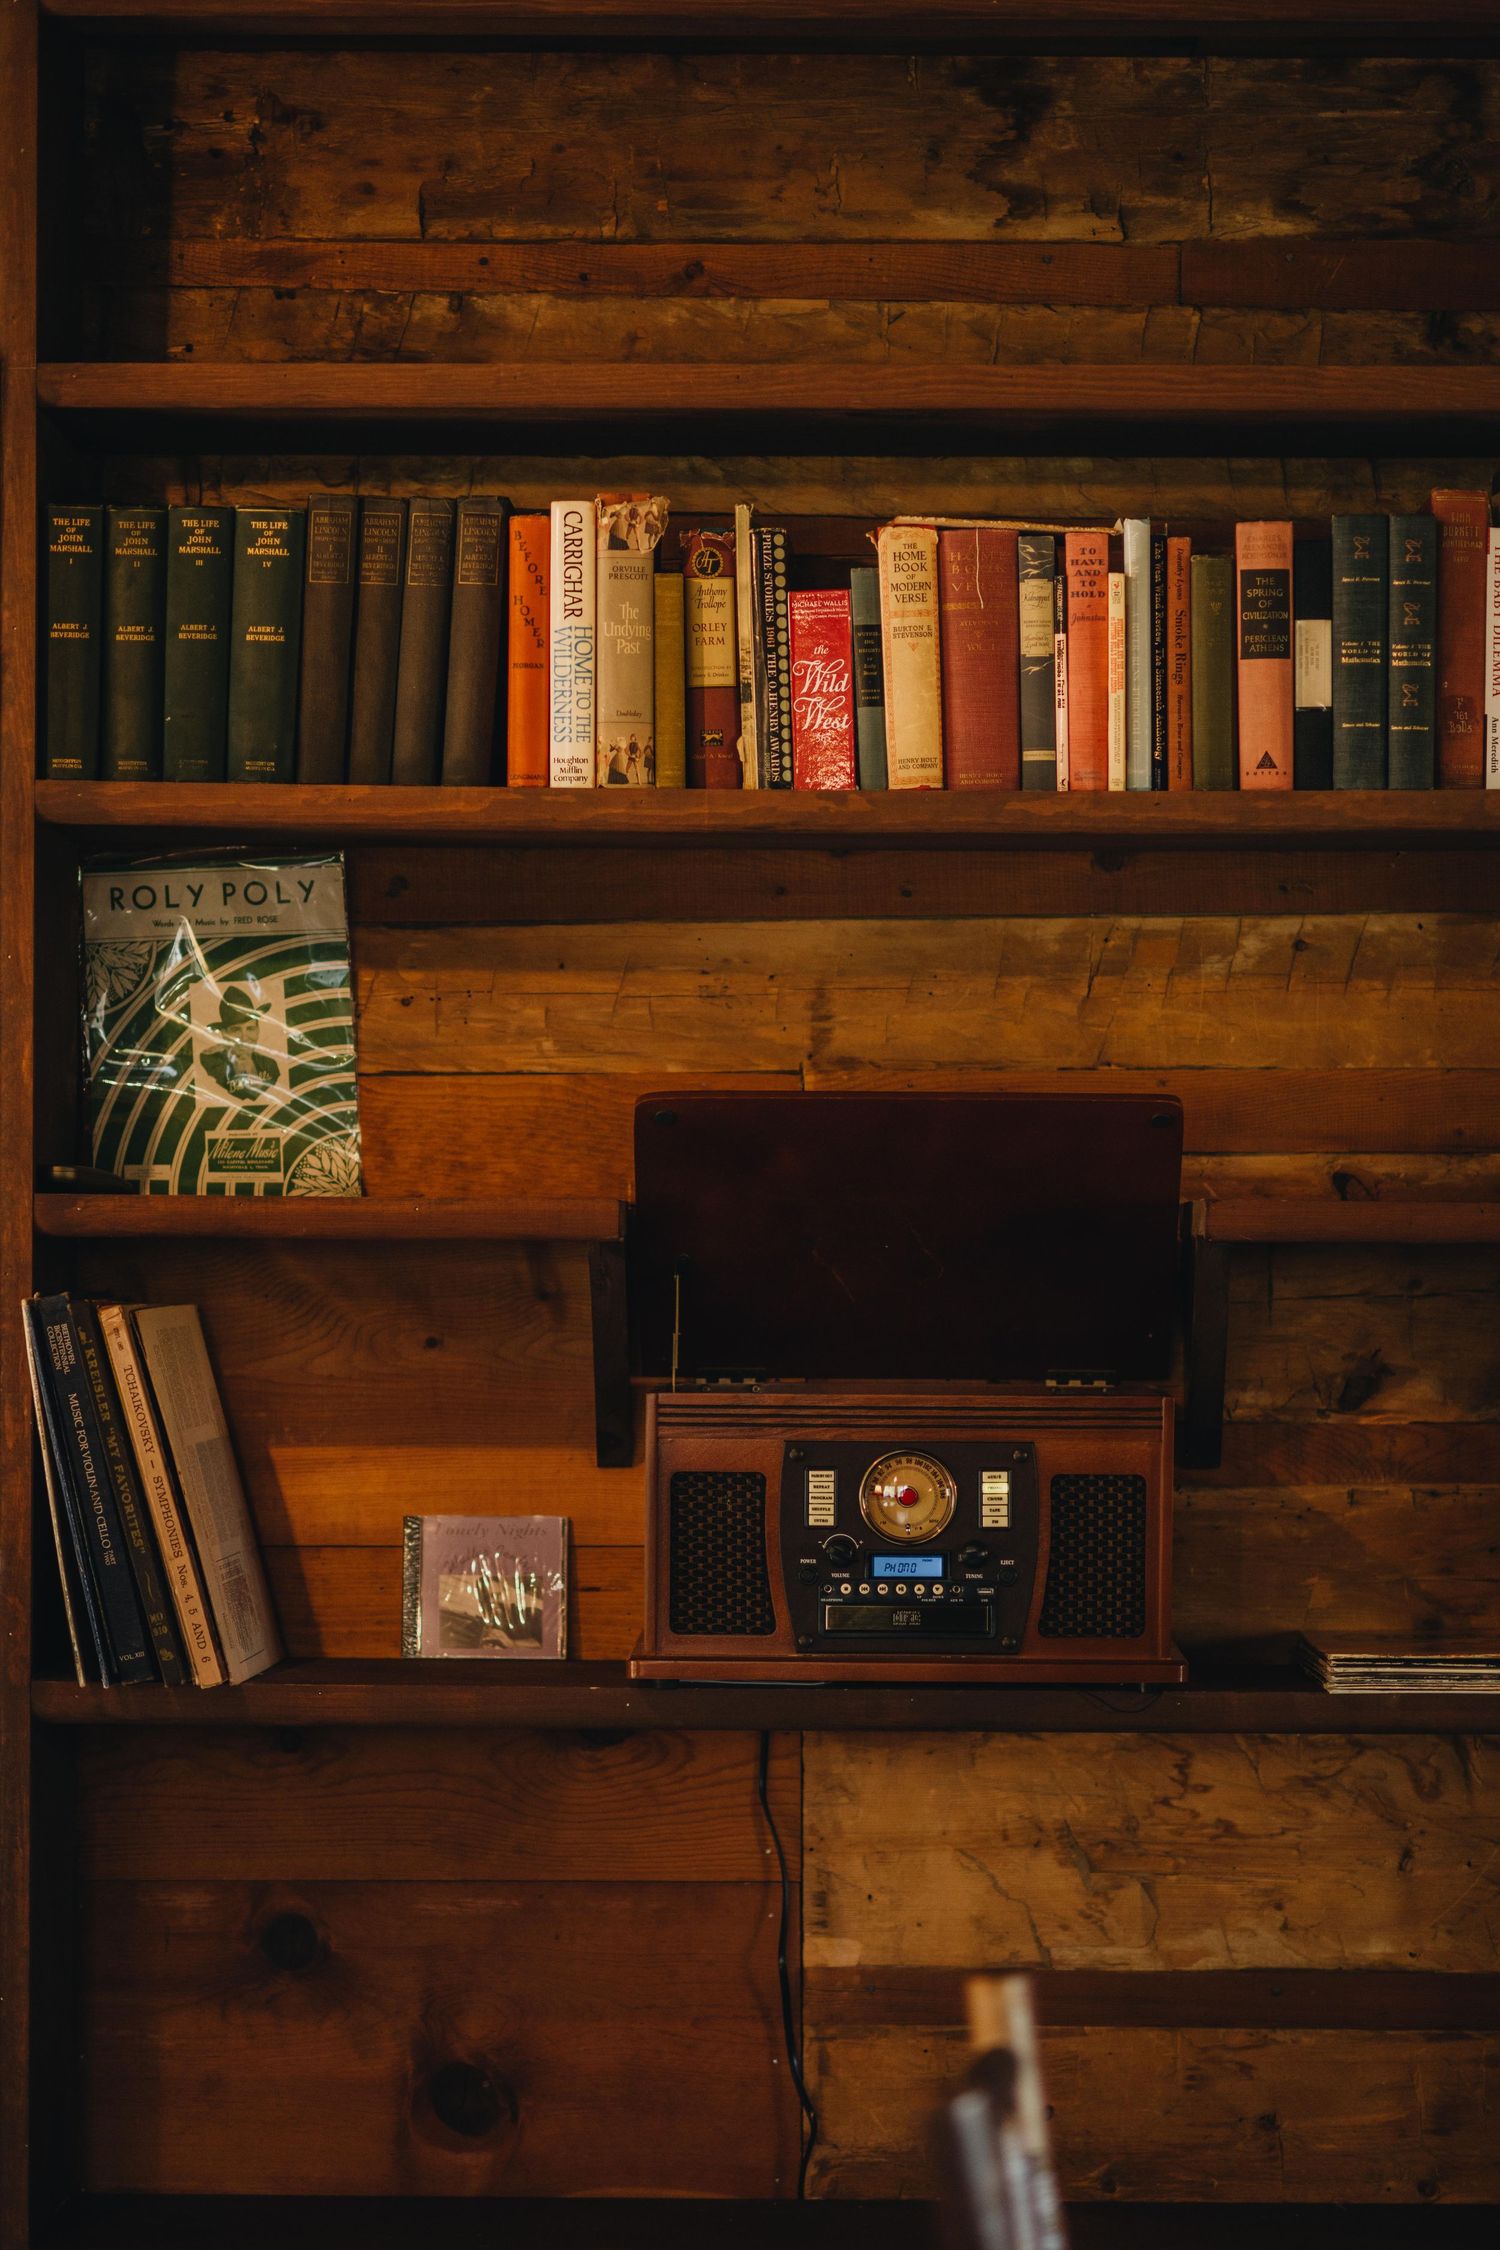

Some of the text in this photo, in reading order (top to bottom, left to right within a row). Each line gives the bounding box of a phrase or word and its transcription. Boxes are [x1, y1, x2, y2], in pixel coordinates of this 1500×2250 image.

[52, 517, 91, 527] THE LIFE
[118, 521, 156, 529] THE LIFE
[182, 519, 220, 528] THE LIFE
[250, 521, 289, 530] THE LIFE
[364, 527, 397, 537] LINCOLN
[463, 527, 497, 536] LINCOLN
[1443, 526, 1479, 537] BURNETT
[58, 534, 84, 543] JOHN
[123, 537, 149, 547] JOHN
[187, 535, 212, 545] JOHN
[255, 537, 281, 547] JOHN
[49, 544, 93, 553] MARSHALL
[115, 547, 158, 556] MARSHALL
[178, 546, 221, 555] MARSHALL
[247, 547, 289, 557] MARSHALL
[1080, 547, 1096, 555] TO
[1155, 542, 1164, 560] The
[893, 551, 927, 561] HOME
[513, 530, 547, 596] BEFORE
[563, 511, 583, 619] CARRIGHAR
[894, 562, 928, 573] BOOK
[1174, 548, 1184, 577] Dorothy
[1155, 563, 1163, 583] West
[890, 581, 932, 592] MODERN
[1256, 577, 1275, 586] THE
[695, 583, 728, 597] Anthony
[1175, 578, 1184, 601] Lyons
[1247, 588, 1283, 598] SPRING
[894, 592, 928, 603] VERSE
[1155, 585, 1164, 609] Wind
[694, 595, 726, 614] Trollope
[791, 600, 823, 608] MICHAEL
[1258, 600, 1272, 608] OF
[619, 601, 640, 620] The
[1242, 611, 1288, 620] CIVILIZATION
[513, 595, 545, 649] HOMER
[1071, 612, 1106, 626] Johnston
[118, 625, 145, 633] ALBERT
[603, 619, 651, 640] Undying
[692, 623, 727, 632] ORLEY
[893, 624, 925, 632] BURTON
[1175, 609, 1186, 649] Smoke
[50, 631, 90, 639] BEVERIDGE
[115, 634, 156, 642] BEVERIDGE
[178, 632, 218, 640] BEVERIDGE
[246, 634, 286, 643] BEVERIDGE
[892, 631, 933, 639] STEVENSON
[1244, 634, 1288, 643] PERICLEAN
[616, 639, 641, 655] Past
[695, 637, 725, 646] FARM
[814, 645, 830, 655] the
[1249, 643, 1285, 653] ATHENS
[762, 533, 781, 782] PRIZE STORIES 1961 THE AWARDS
[1155, 649, 1165, 666] The
[1341, 656, 1381, 664] Mathematics
[1391, 659, 1432, 667] Mathematics
[1492, 624, 1500, 698] DILEMMA
[1171, 652, 1186, 685] Rings
[793, 658, 850, 694] Wild
[553, 625, 573, 743] WILDERNESS
[574, 625, 593, 743] HOME TO THE
[1155, 668, 1164, 711] Sixteenth
[793, 695, 853, 731] West
[1153, 713, 1165, 761] Anthology
[1490, 716, 1499, 773] Ann Meredith
[553, 756, 589, 767] Houghton
[898, 757, 919, 765] HENRY
[560, 766, 583, 774] Mifflin
[553, 774, 589, 784] Company
[110, 879, 315, 911] ROLY POLY
[152, 915, 279, 928] Words Music by FRED ROSE
[244, 1137, 279, 1159] Music
[46, 1326, 63, 1371] COLLECTION
[61, 1323, 77, 1365] BEETHOVEN
[53, 1325, 71, 1375] BICENTENNIAL
[84, 1347, 111, 1422] KREISLER
[67, 1393, 111, 1550] MUSIC FOR VIOLIN AND CELLO
[123, 1365, 155, 1453] TCHAIKOVSKY
[152, 1476, 183, 1558] SYMPHONIES
[177, 1564, 189, 1588] Nos.
[192, 1622, 207, 1650] AND
[499, 1522, 547, 1539] Nights
